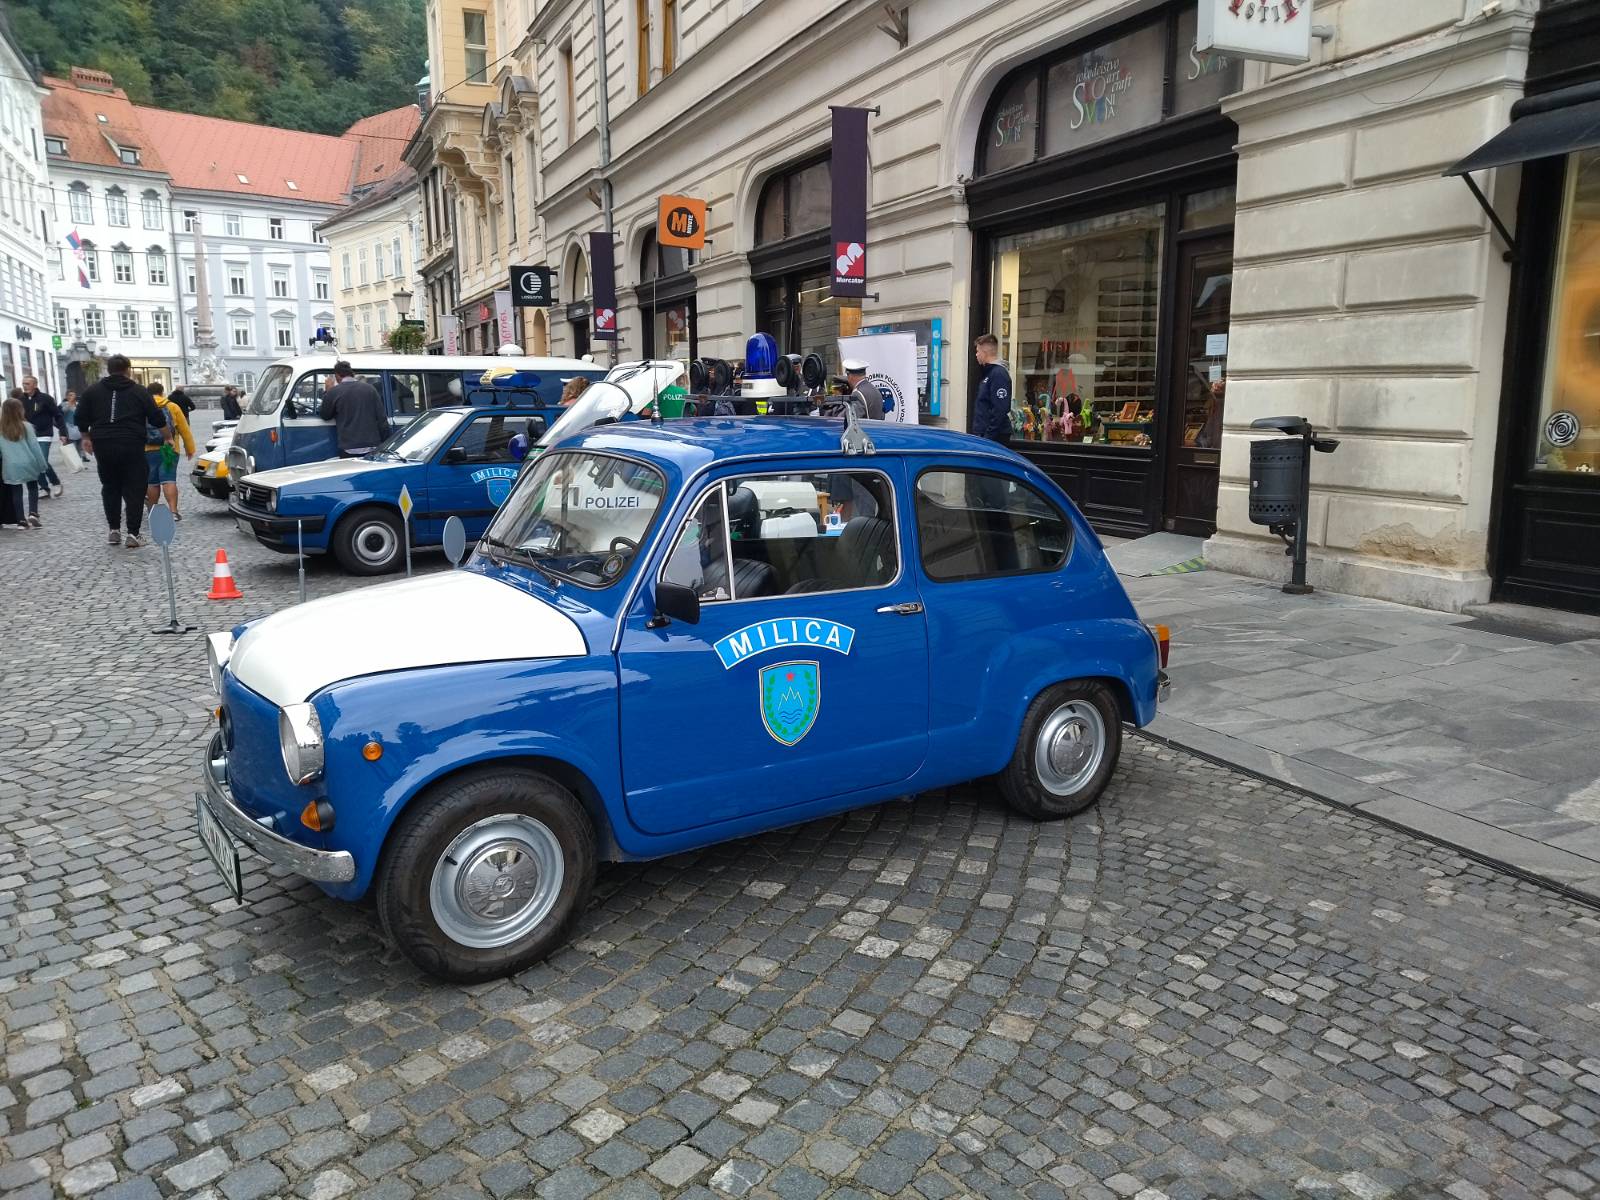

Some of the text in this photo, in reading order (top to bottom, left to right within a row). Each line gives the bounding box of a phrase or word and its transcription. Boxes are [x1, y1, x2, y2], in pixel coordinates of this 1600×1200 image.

[663, 393, 683, 401] POLIZ
[476, 468, 518, 480] MILICA
[585, 496, 640, 509] POLIZEI
[728, 620, 841, 659] MILICA
